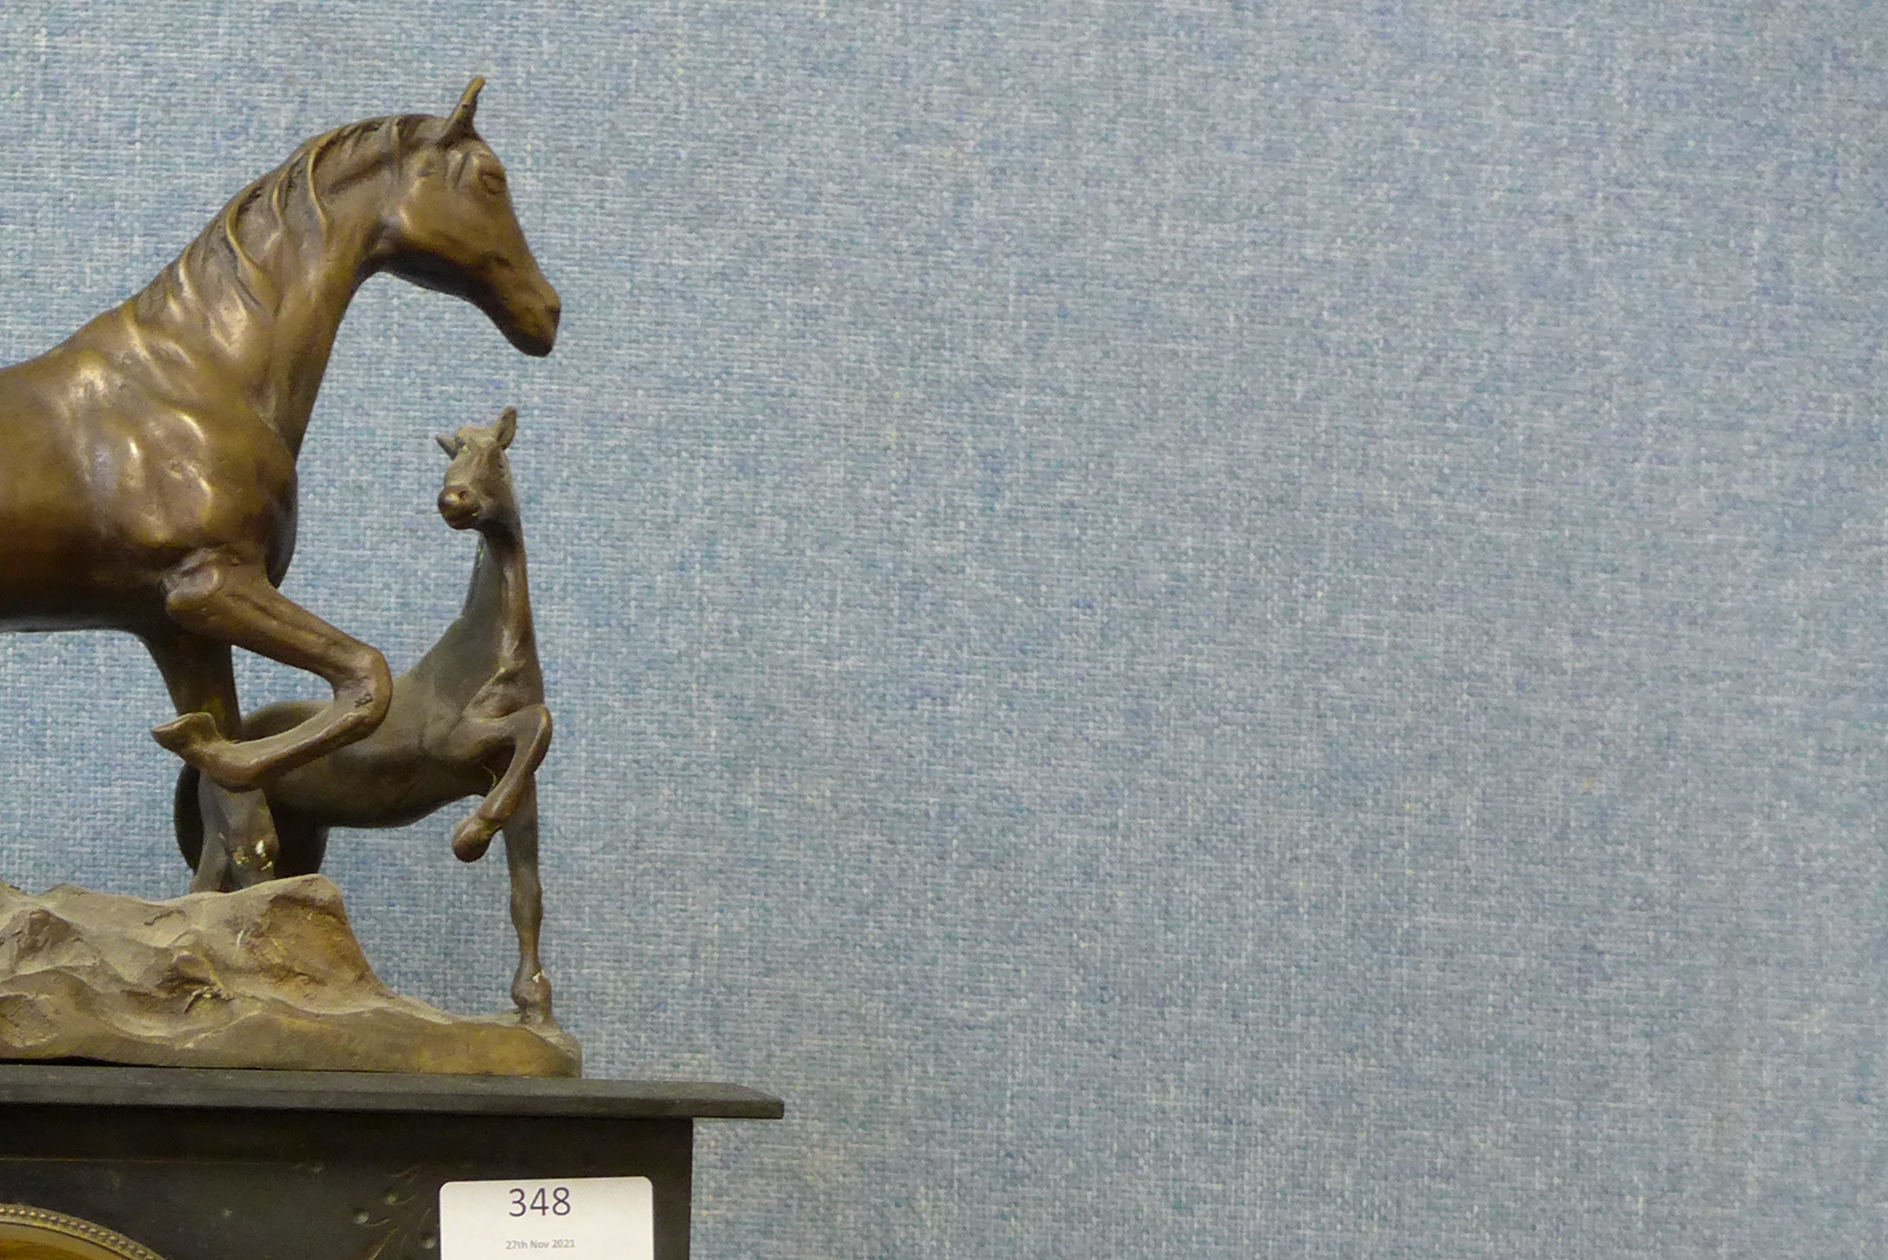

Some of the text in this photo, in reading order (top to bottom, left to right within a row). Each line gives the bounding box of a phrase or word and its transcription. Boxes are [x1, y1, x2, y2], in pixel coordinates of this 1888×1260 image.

[508, 1186, 572, 1218] 348
[505, 1238, 576, 1250] 27th Nov 2021
